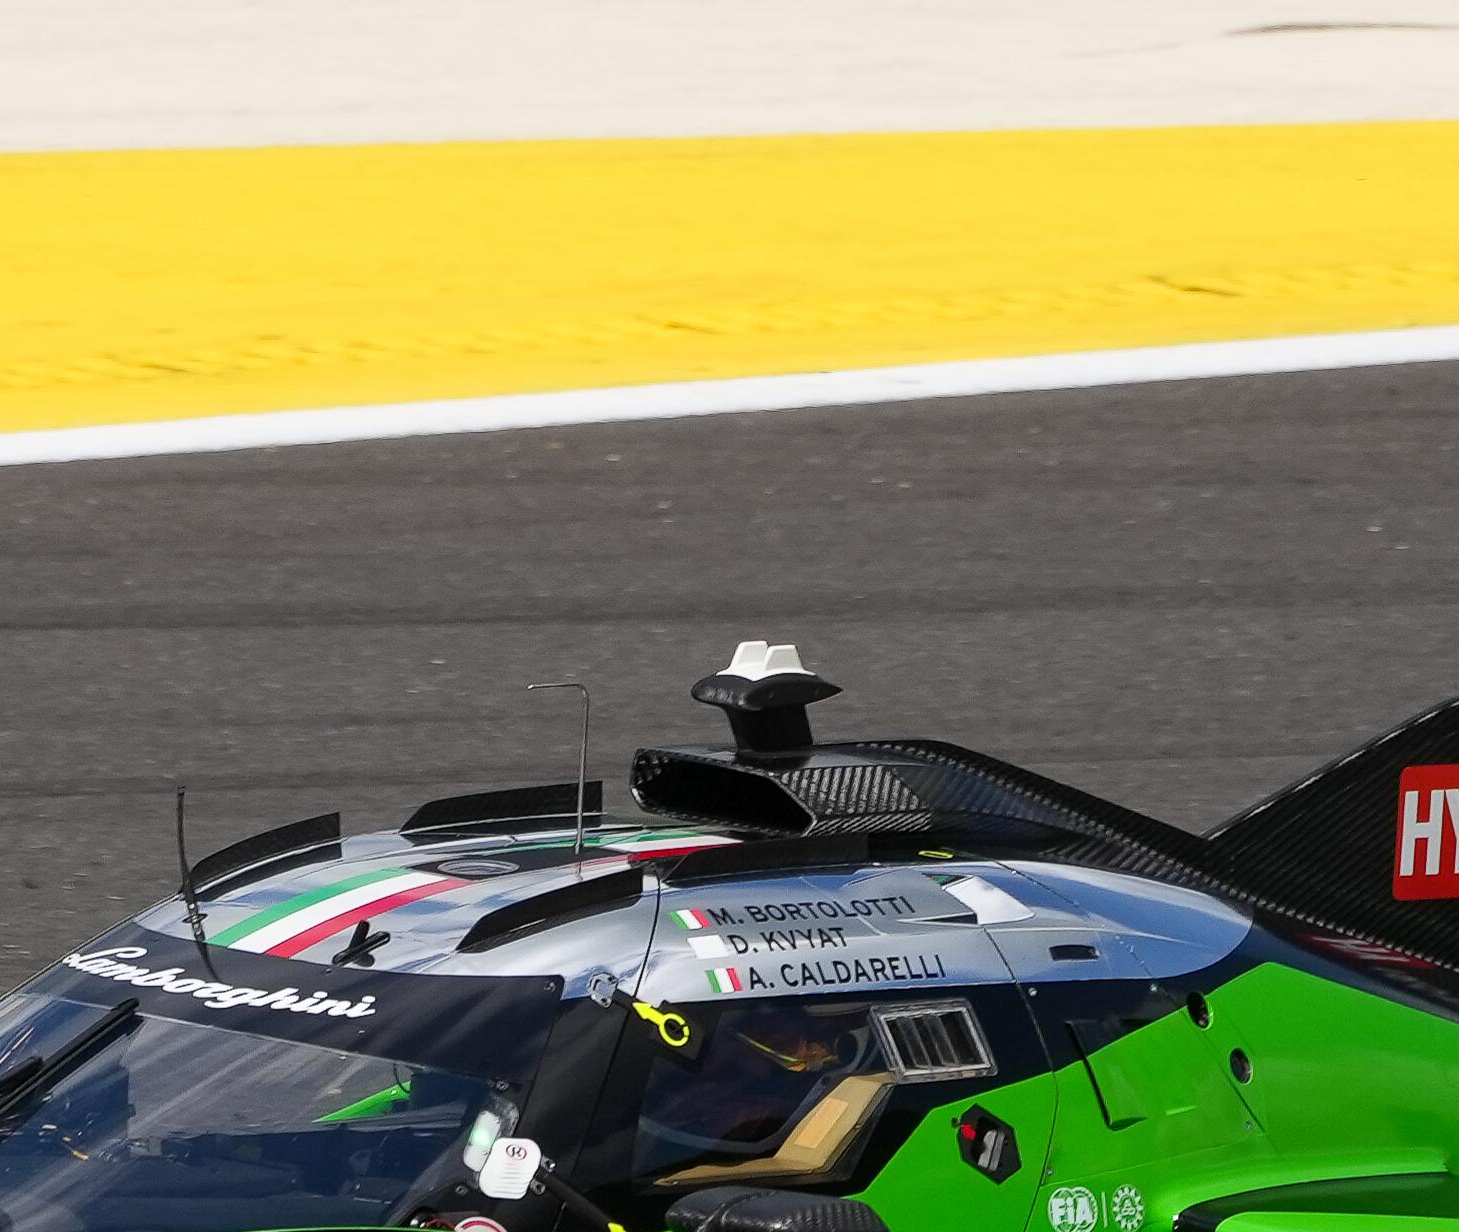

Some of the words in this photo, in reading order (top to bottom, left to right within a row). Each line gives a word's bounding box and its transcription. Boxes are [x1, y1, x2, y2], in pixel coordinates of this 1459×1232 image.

[707, 908, 743, 927] M.
[744, 896, 916, 923] BORTOLOTTI
[727, 934, 759, 955] D.
[760, 928, 848, 951] KVYAT
[62, 946, 376, 1018] Lamborghini
[748, 966, 775, 990] A.
[780, 954, 947, 988] CALDARELLI
